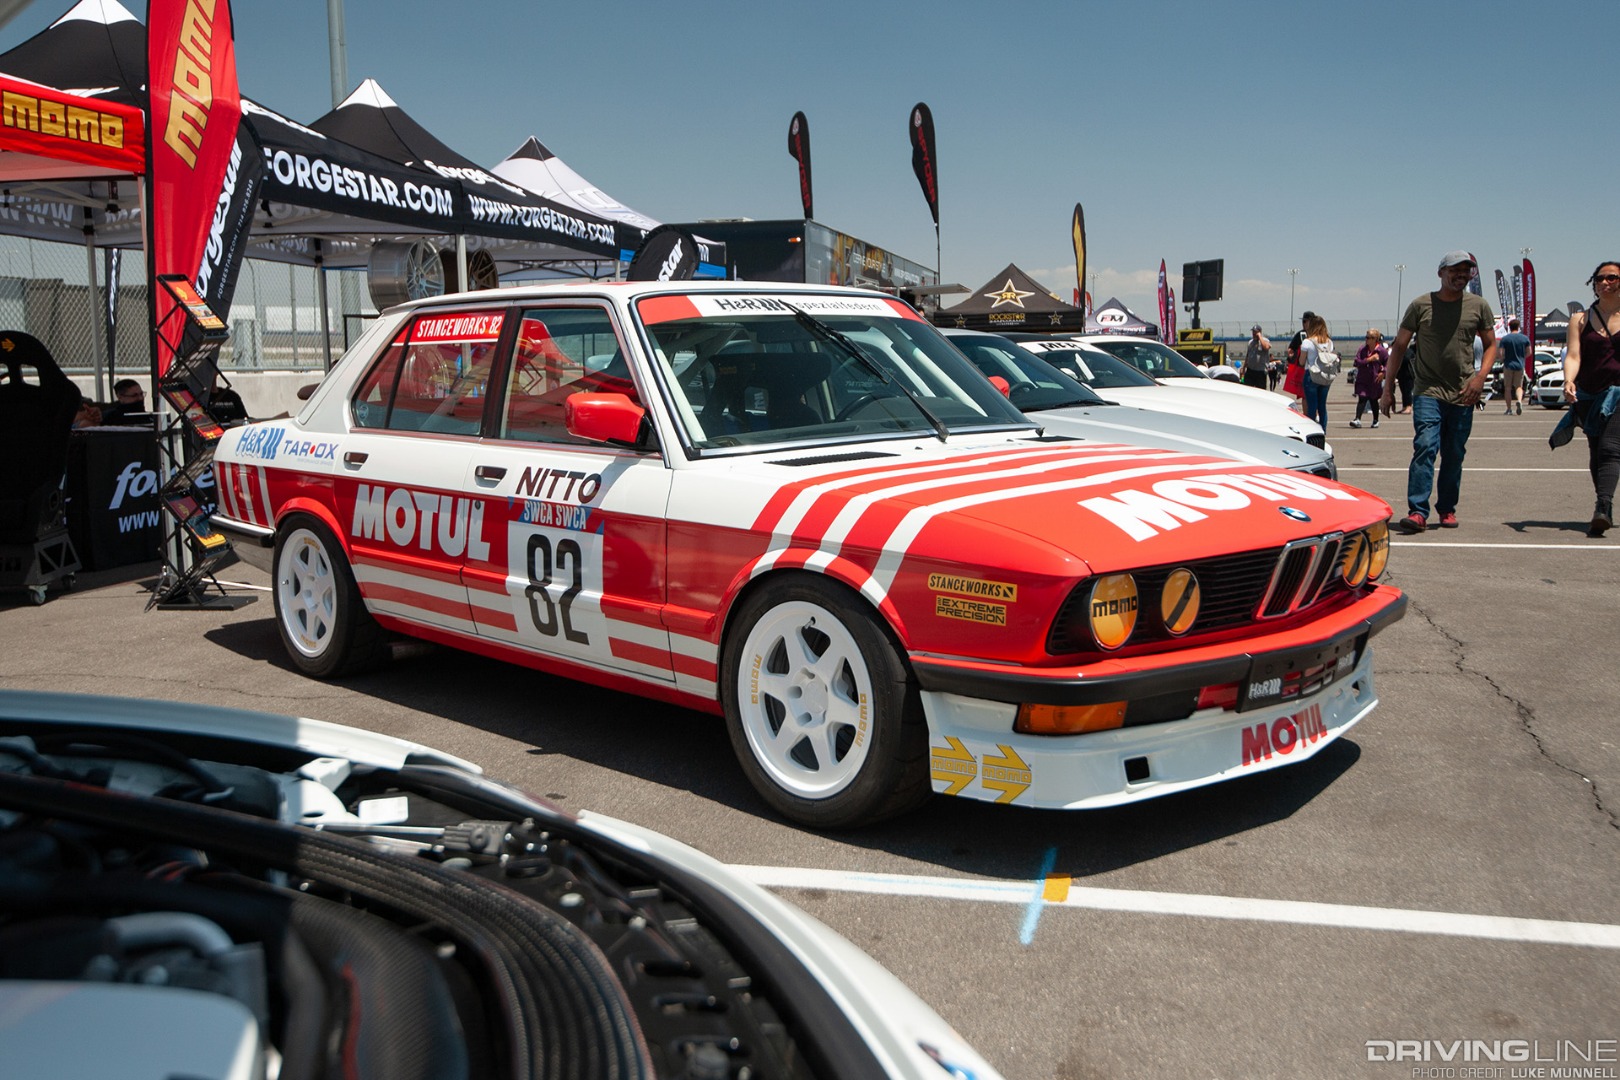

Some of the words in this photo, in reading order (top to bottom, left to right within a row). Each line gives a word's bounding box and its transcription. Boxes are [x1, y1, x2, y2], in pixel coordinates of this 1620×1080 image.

[2, 90, 124, 149] momo
[262, 147, 454, 217] FORGESTAR.COM
[467, 194, 616, 247] WWW.FORGESTAR.COM
[417, 316, 488, 338] STANCEWORKS
[488, 315, 503, 334] 82
[235, 427, 270, 459] H&R
[515, 466, 602, 504] NITTO
[351, 483, 491, 562] MOTUL
[523, 500, 553, 526] SWCA
[555, 504, 587, 530] SWCA
[1076, 473, 1360, 543] MOTUL
[524, 533, 590, 646] 82
[929, 575, 1002, 598] STANCEWORKS
[942, 598, 1006, 616] EXTREME
[937, 606, 1006, 625] PRECISION
[1241, 702, 1328, 767] MOTUL
